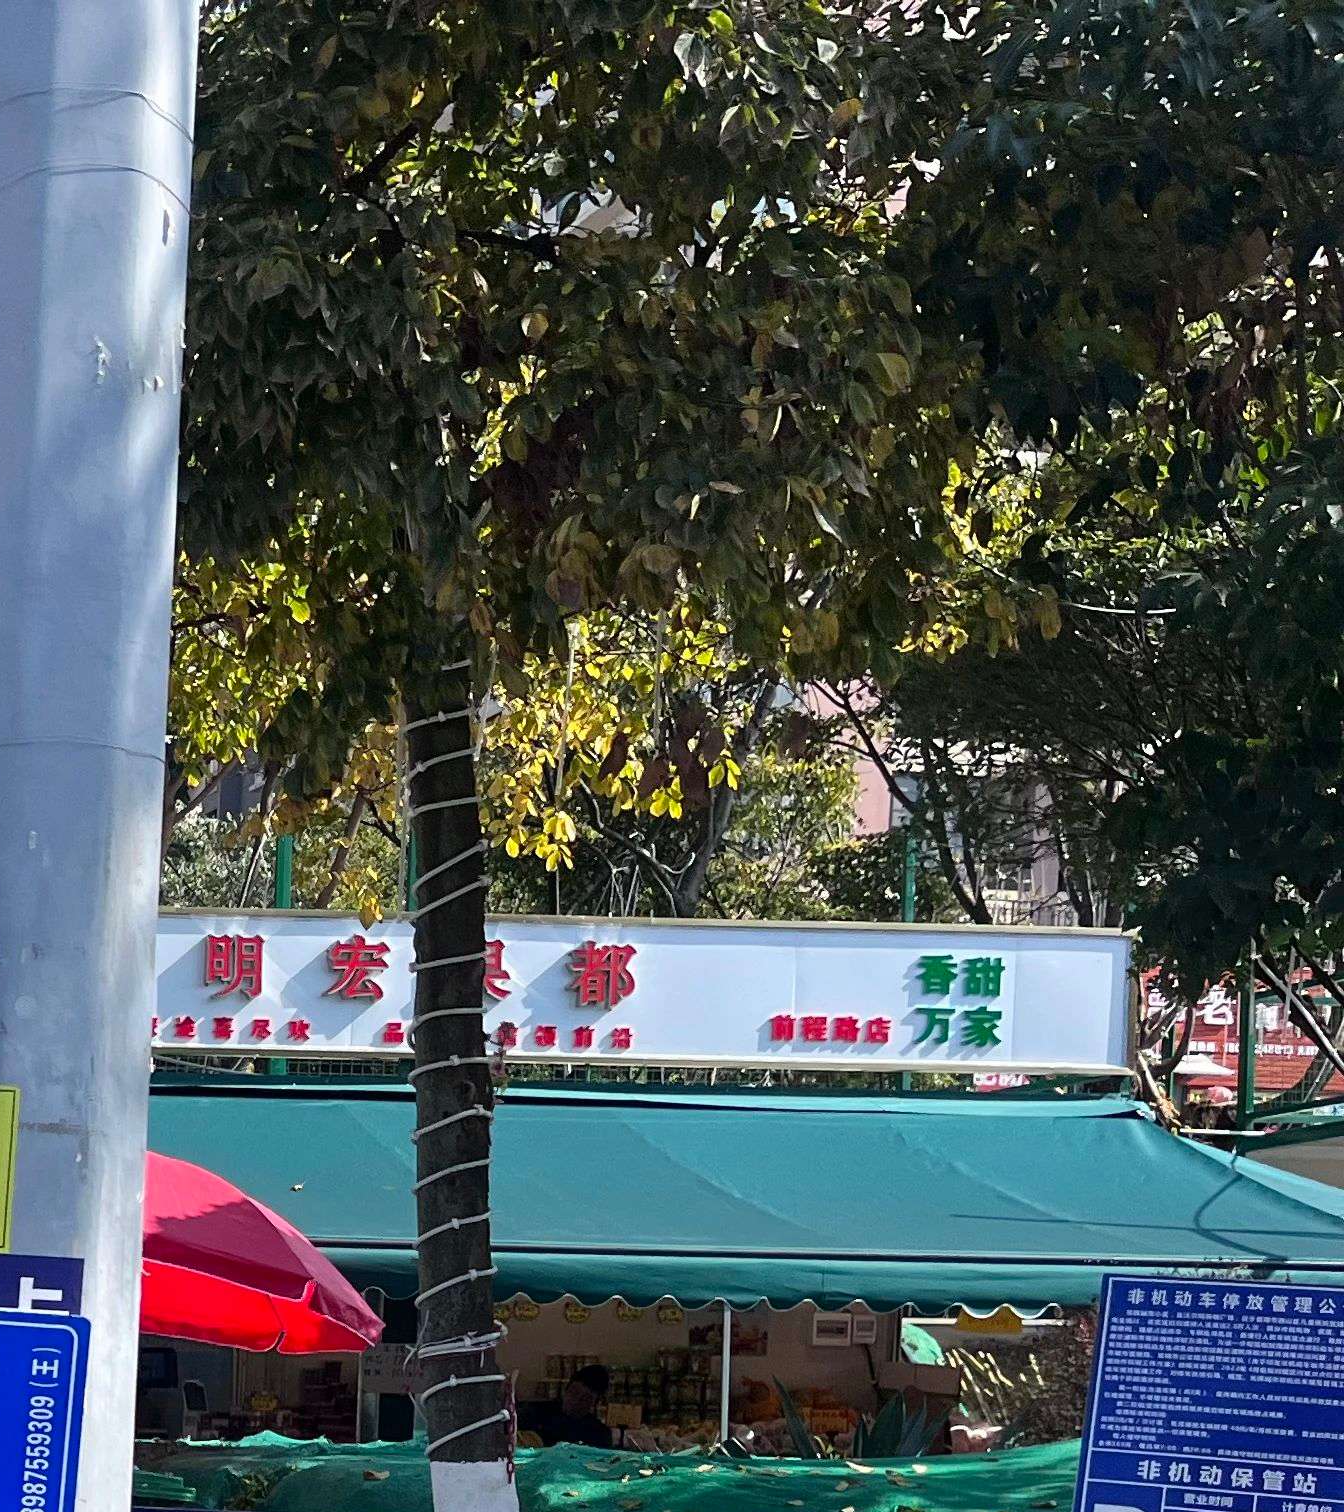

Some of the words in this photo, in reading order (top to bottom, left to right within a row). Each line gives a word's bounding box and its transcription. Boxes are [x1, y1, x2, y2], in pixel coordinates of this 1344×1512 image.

[916, 954, 1005, 998] 香甜
[769, 1015, 891, 1044] 前程路店
[914, 1005, 1002, 1047] 万家
[1128, 1288, 1344, 1315] 非机动车停放管理公
[1137, 1460, 1317, 1495] 非机动保管站
[1184, 1494, 1233, 1508] 营业时间
